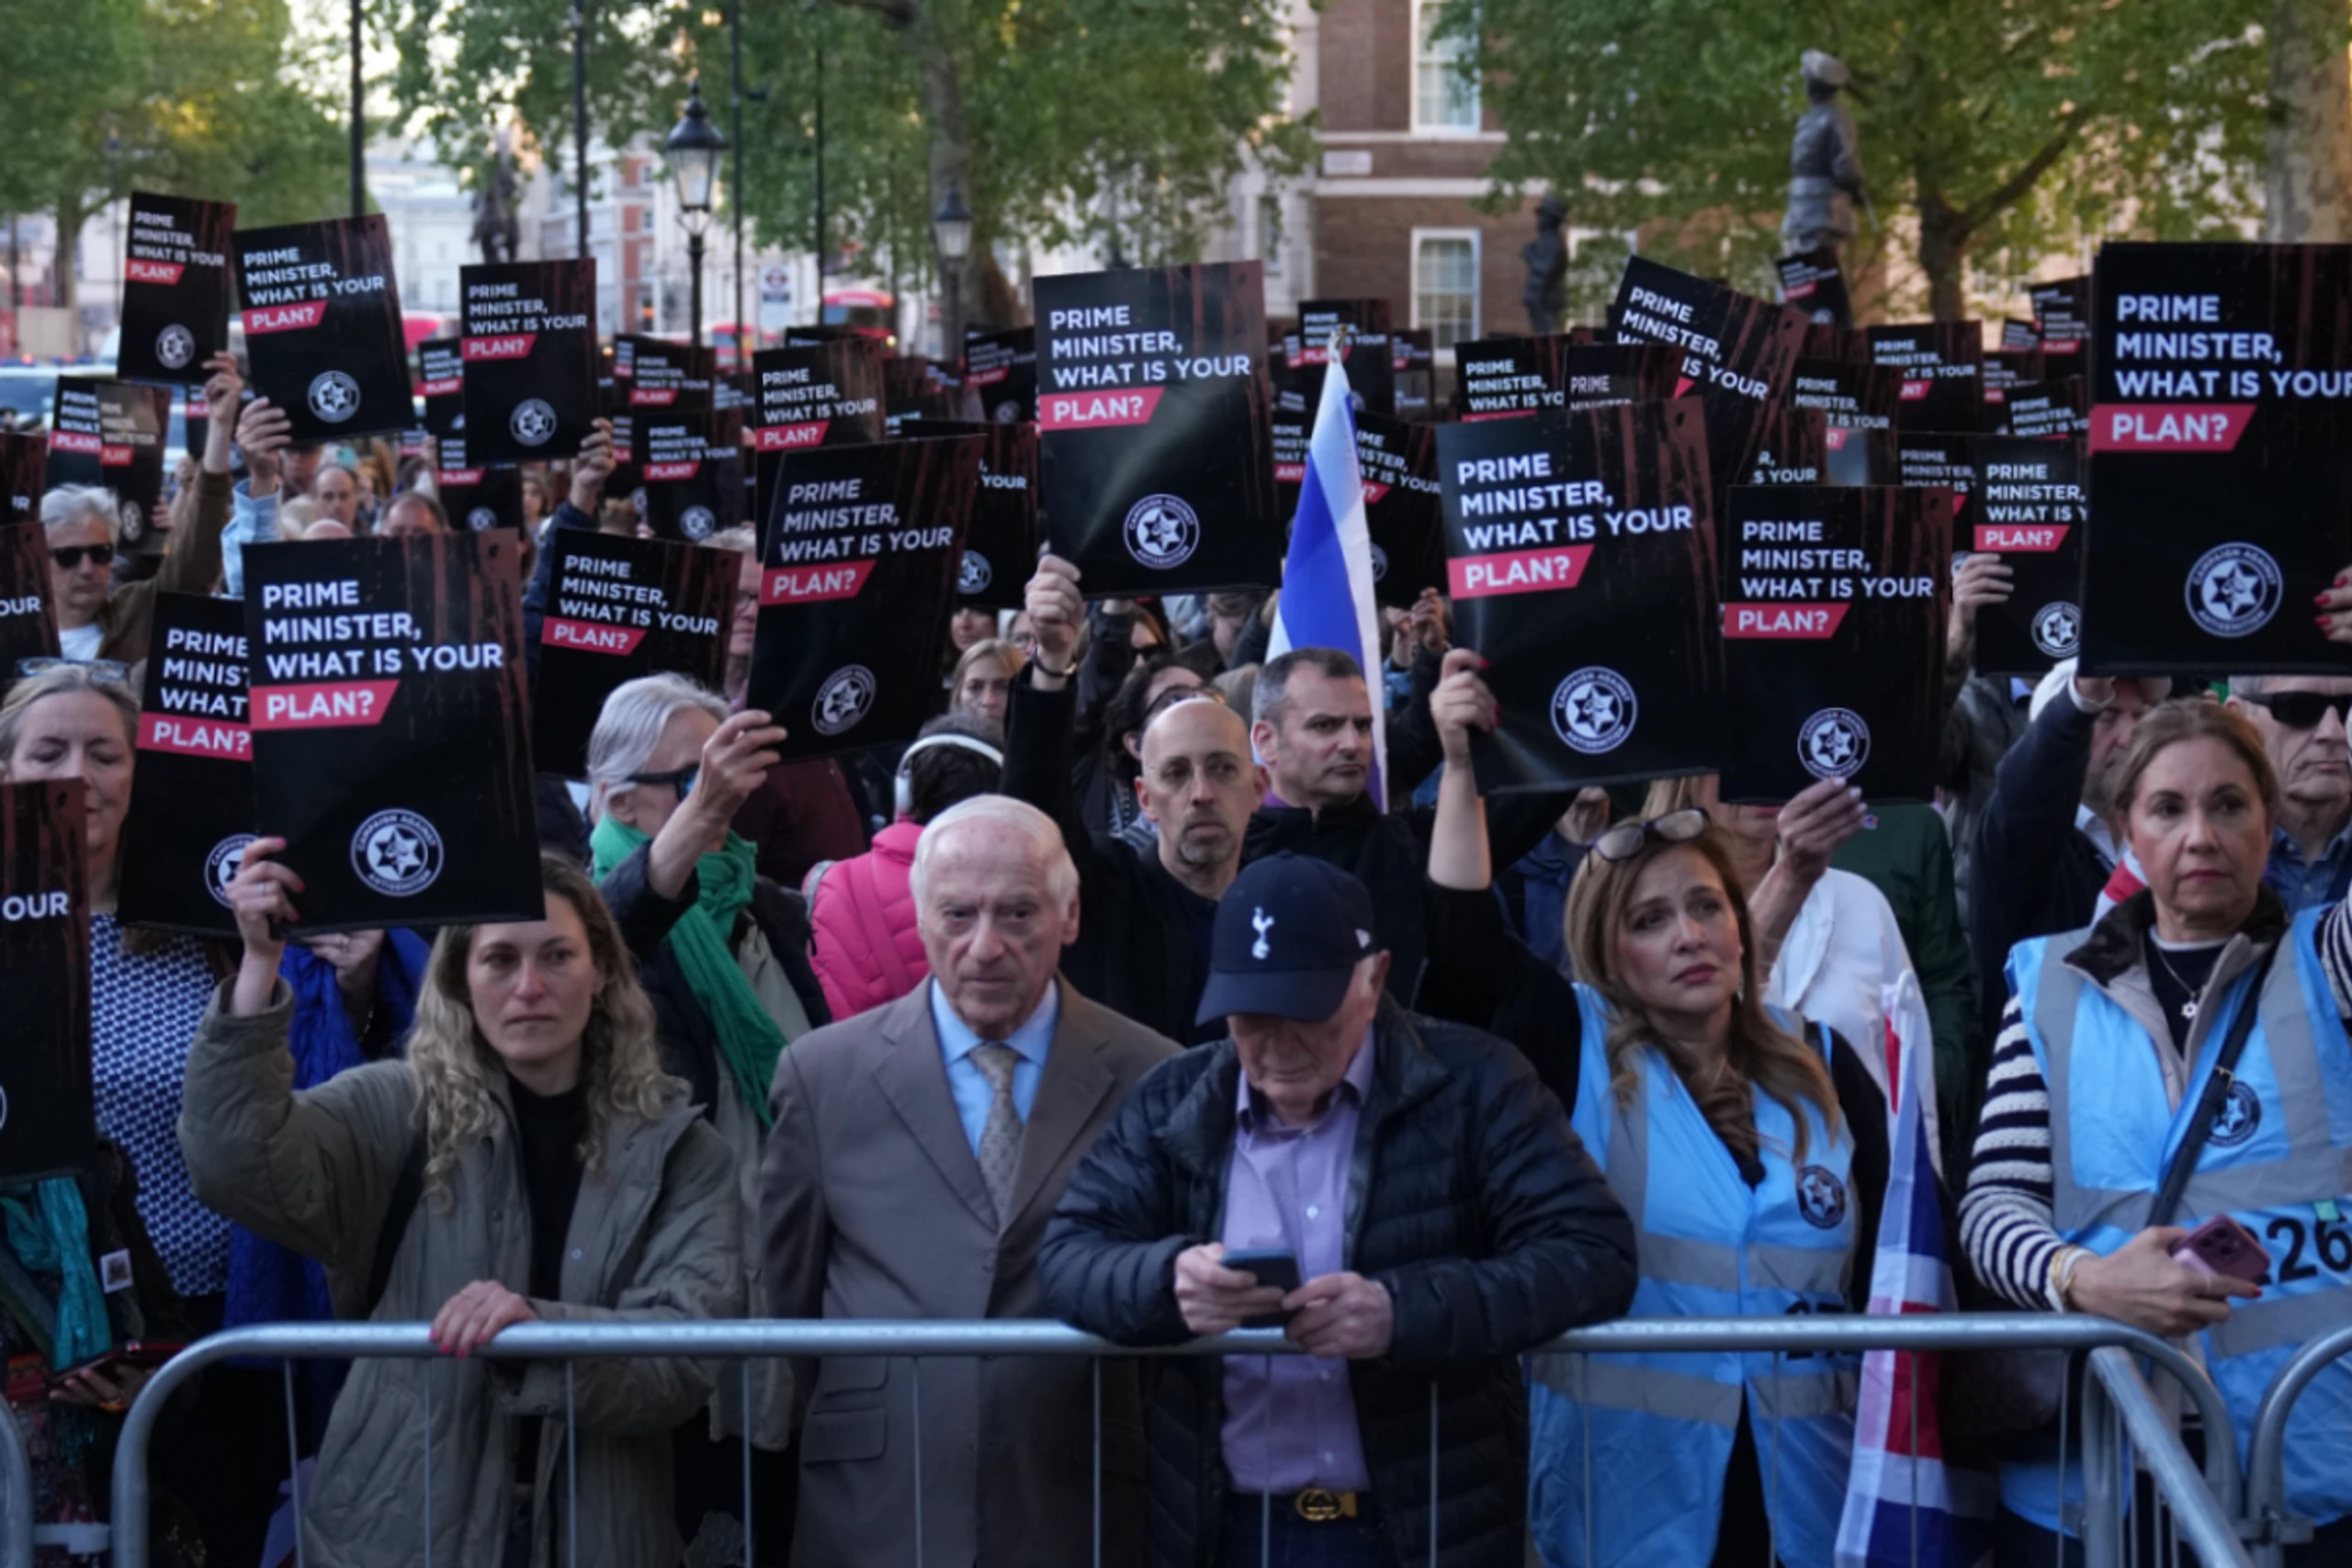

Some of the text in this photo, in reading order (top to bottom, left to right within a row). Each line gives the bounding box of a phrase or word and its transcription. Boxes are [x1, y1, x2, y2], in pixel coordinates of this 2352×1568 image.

[135, 211, 173, 226] PRIME
[134, 228, 195, 248] MINISTER,
[133, 246, 224, 266] WHAT IS YOUR
[244, 248, 300, 266] PRIME
[130, 265, 174, 281] PLAN?
[246, 263, 337, 286] MINISTER,
[249, 277, 383, 305] WHAT IS YOUR
[469, 284, 517, 298] PRIME
[470, 299, 548, 315] MINISTER,
[1629, 287, 1695, 324] PRIME
[2118, 296, 2219, 321] PRIME
[252, 308, 312, 328] PLAN?
[470, 316, 586, 333] WHAT IS YOUR
[1050, 306, 1132, 330] PRIME
[1052, 332, 1184, 358] MINISTER,
[1622, 310, 1723, 363] MINISTER,
[1874, 340, 1916, 351] PRIME
[471, 340, 524, 355] PLAN?
[2118, 333, 2281, 363] MINISTER,
[1466, 360, 1515, 375] PRIME
[1875, 353, 1941, 365] MINISTER,
[763, 367, 809, 385] PRIME
[1054, 356, 1250, 387] WHAT IS YOUR
[1684, 358, 1767, 401] IS YOUR
[1922, 367, 1933, 378] IS
[1937, 367, 1974, 377] YOUR
[764, 384, 839, 403] MINISTER,
[1468, 375, 1545, 392] MINISTER,
[1570, 375, 1610, 393] PRIME
[1797, 378, 1837, 391] PRIME
[2116, 371, 2220, 396] WHAT
[2231, 372, 2258, 396] IS
[1055, 396, 1145, 422] PLAN?
[1469, 395, 1518, 411] WHAT
[1523, 394, 1537, 406] IS
[1542, 391, 1564, 405] YO
[1796, 394, 1860, 412] MINISTER,
[2011, 397, 2051, 412] PRIME
[764, 400, 876, 423] WHAT IS YOUR
[1838, 414, 1889, 428] IS YOUR
[2013, 407, 2075, 424] MINISTER,
[765, 428, 816, 446] PLAN?
[1272, 424, 1303, 436] RIME
[2057, 422, 2069, 432] IS
[2112, 415, 2227, 441] PLAN?
[1901, 450, 1947, 461] PRIME
[1380, 468, 1395, 484] IS
[1457, 454, 1553, 484] PRIME
[1770, 468, 1817, 483] YOUR
[1903, 466, 1975, 479] MINISTER,
[1987, 464, 2047, 479] PRIME
[981, 475, 1027, 489] YOUR
[1954, 481, 1967, 491] IS
[787, 480, 860, 505] PRIME
[1461, 481, 1614, 516] MINISTER,
[1986, 485, 2086, 502] MINISTER,
[784, 504, 899, 534] MINISTER,
[1987, 506, 2049, 520] WHAT
[2054, 507, 2072, 521] IS
[1464, 507, 1692, 548] WHAT IS YOUR
[1743, 522, 1822, 540] PRIME
[782, 527, 953, 562] WHAT IS YOUR
[1986, 531, 2052, 546] PLAN?
[565, 555, 631, 578] PRIME
[1743, 549, 1871, 572] MINISTER,
[1466, 556, 1570, 588] PLAN?
[563, 576, 668, 608] MINISTER,
[774, 570, 855, 597] PLAN?
[1742, 579, 1933, 597] WHAT IS YOUR
[263, 581, 361, 609] PRIME
[0, 596, 40, 616] OUR
[561, 599, 718, 634] WHAT IS YOUR
[1738, 611, 1827, 630] PLAN?
[266, 613, 424, 643] MINISTER,
[555, 624, 629, 649] PLAN?
[165, 628, 248, 658] PRIME
[266, 645, 503, 680] WHAT IS YOUR
[163, 658, 249, 688] MINIS
[162, 688, 245, 716] WHAT
[266, 690, 375, 721] PLAN?
[154, 722, 248, 753] PLAN?
[2, 891, 69, 920] OUR
[2245, 1216, 2352, 1285] 26
